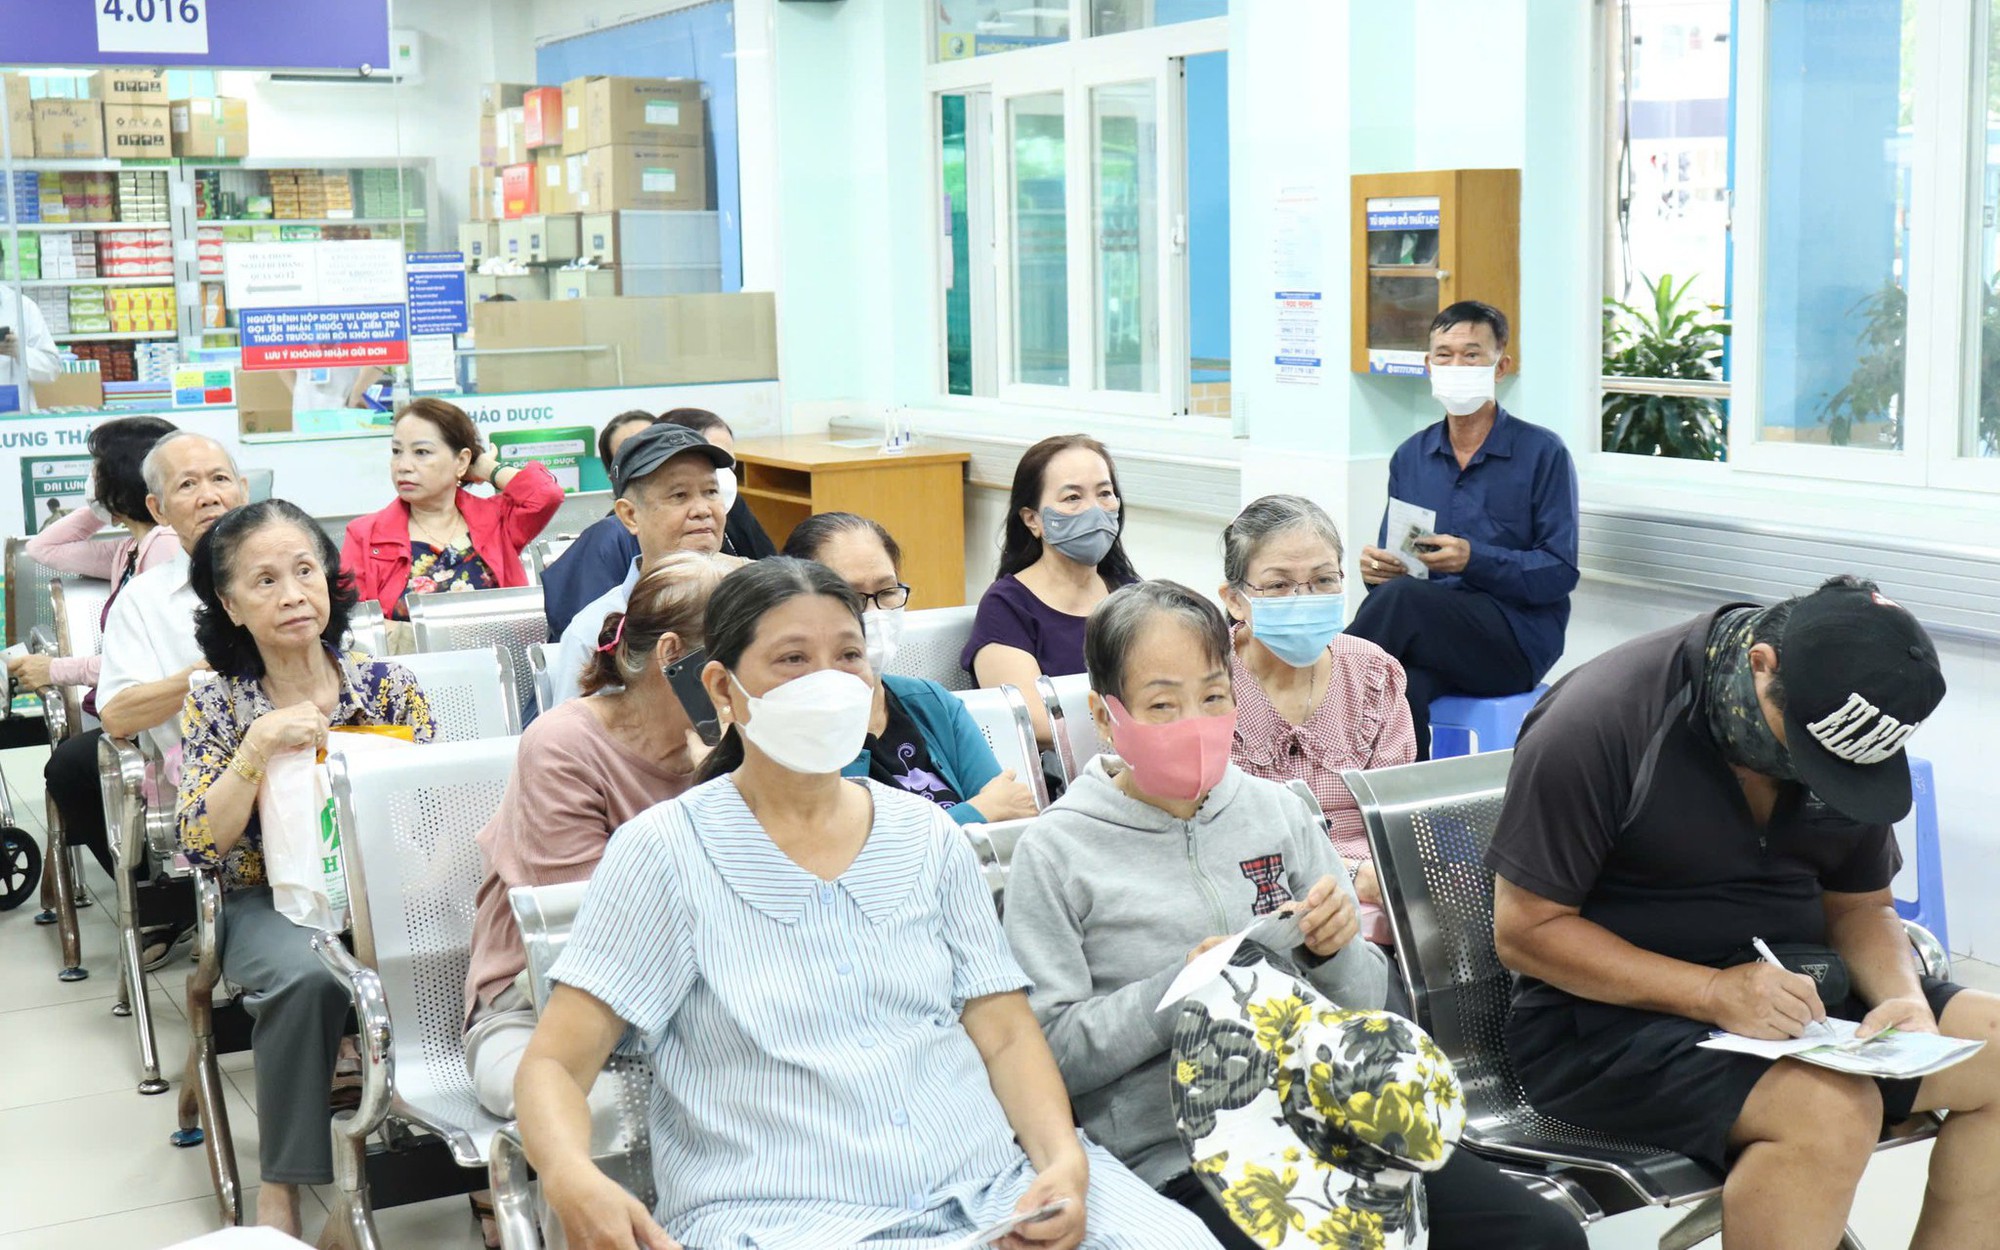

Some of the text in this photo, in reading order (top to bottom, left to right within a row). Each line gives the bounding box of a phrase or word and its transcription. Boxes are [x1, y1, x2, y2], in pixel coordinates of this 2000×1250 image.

[103, 0, 199, 23] 4.016
[247, 310, 400, 325] NGƯỜI BỆNH NỘP ĐƠN VUI LÒNG CHỜ
[247, 325, 265, 334] GỌI
[267, 323, 283, 333] TÊN
[314, 321, 344, 331] THUỐC
[346, 321, 360, 330] VÀ
[362, 320, 382, 330] KIỂM
[385, 320, 401, 329] TRA
[253, 332, 284, 343] THUỐC
[285, 331, 314, 342] TRƯỚC
[316, 333, 330, 341] KHI
[349, 330, 370, 339] KHỎI
[371, 329, 396, 339] QUẦY
[264, 351, 281, 360] LƯU
[282, 349, 289, 359] Ý
[290, 348, 323, 358] KHÔNG
[324, 348, 349, 359] NHẬN
[367, 346, 388, 356] ĐƠN
[467, 405, 553, 424] HẢO DƯỢC
[54, 424, 92, 446] THẢ
[64, 480, 86, 491] LƯN
